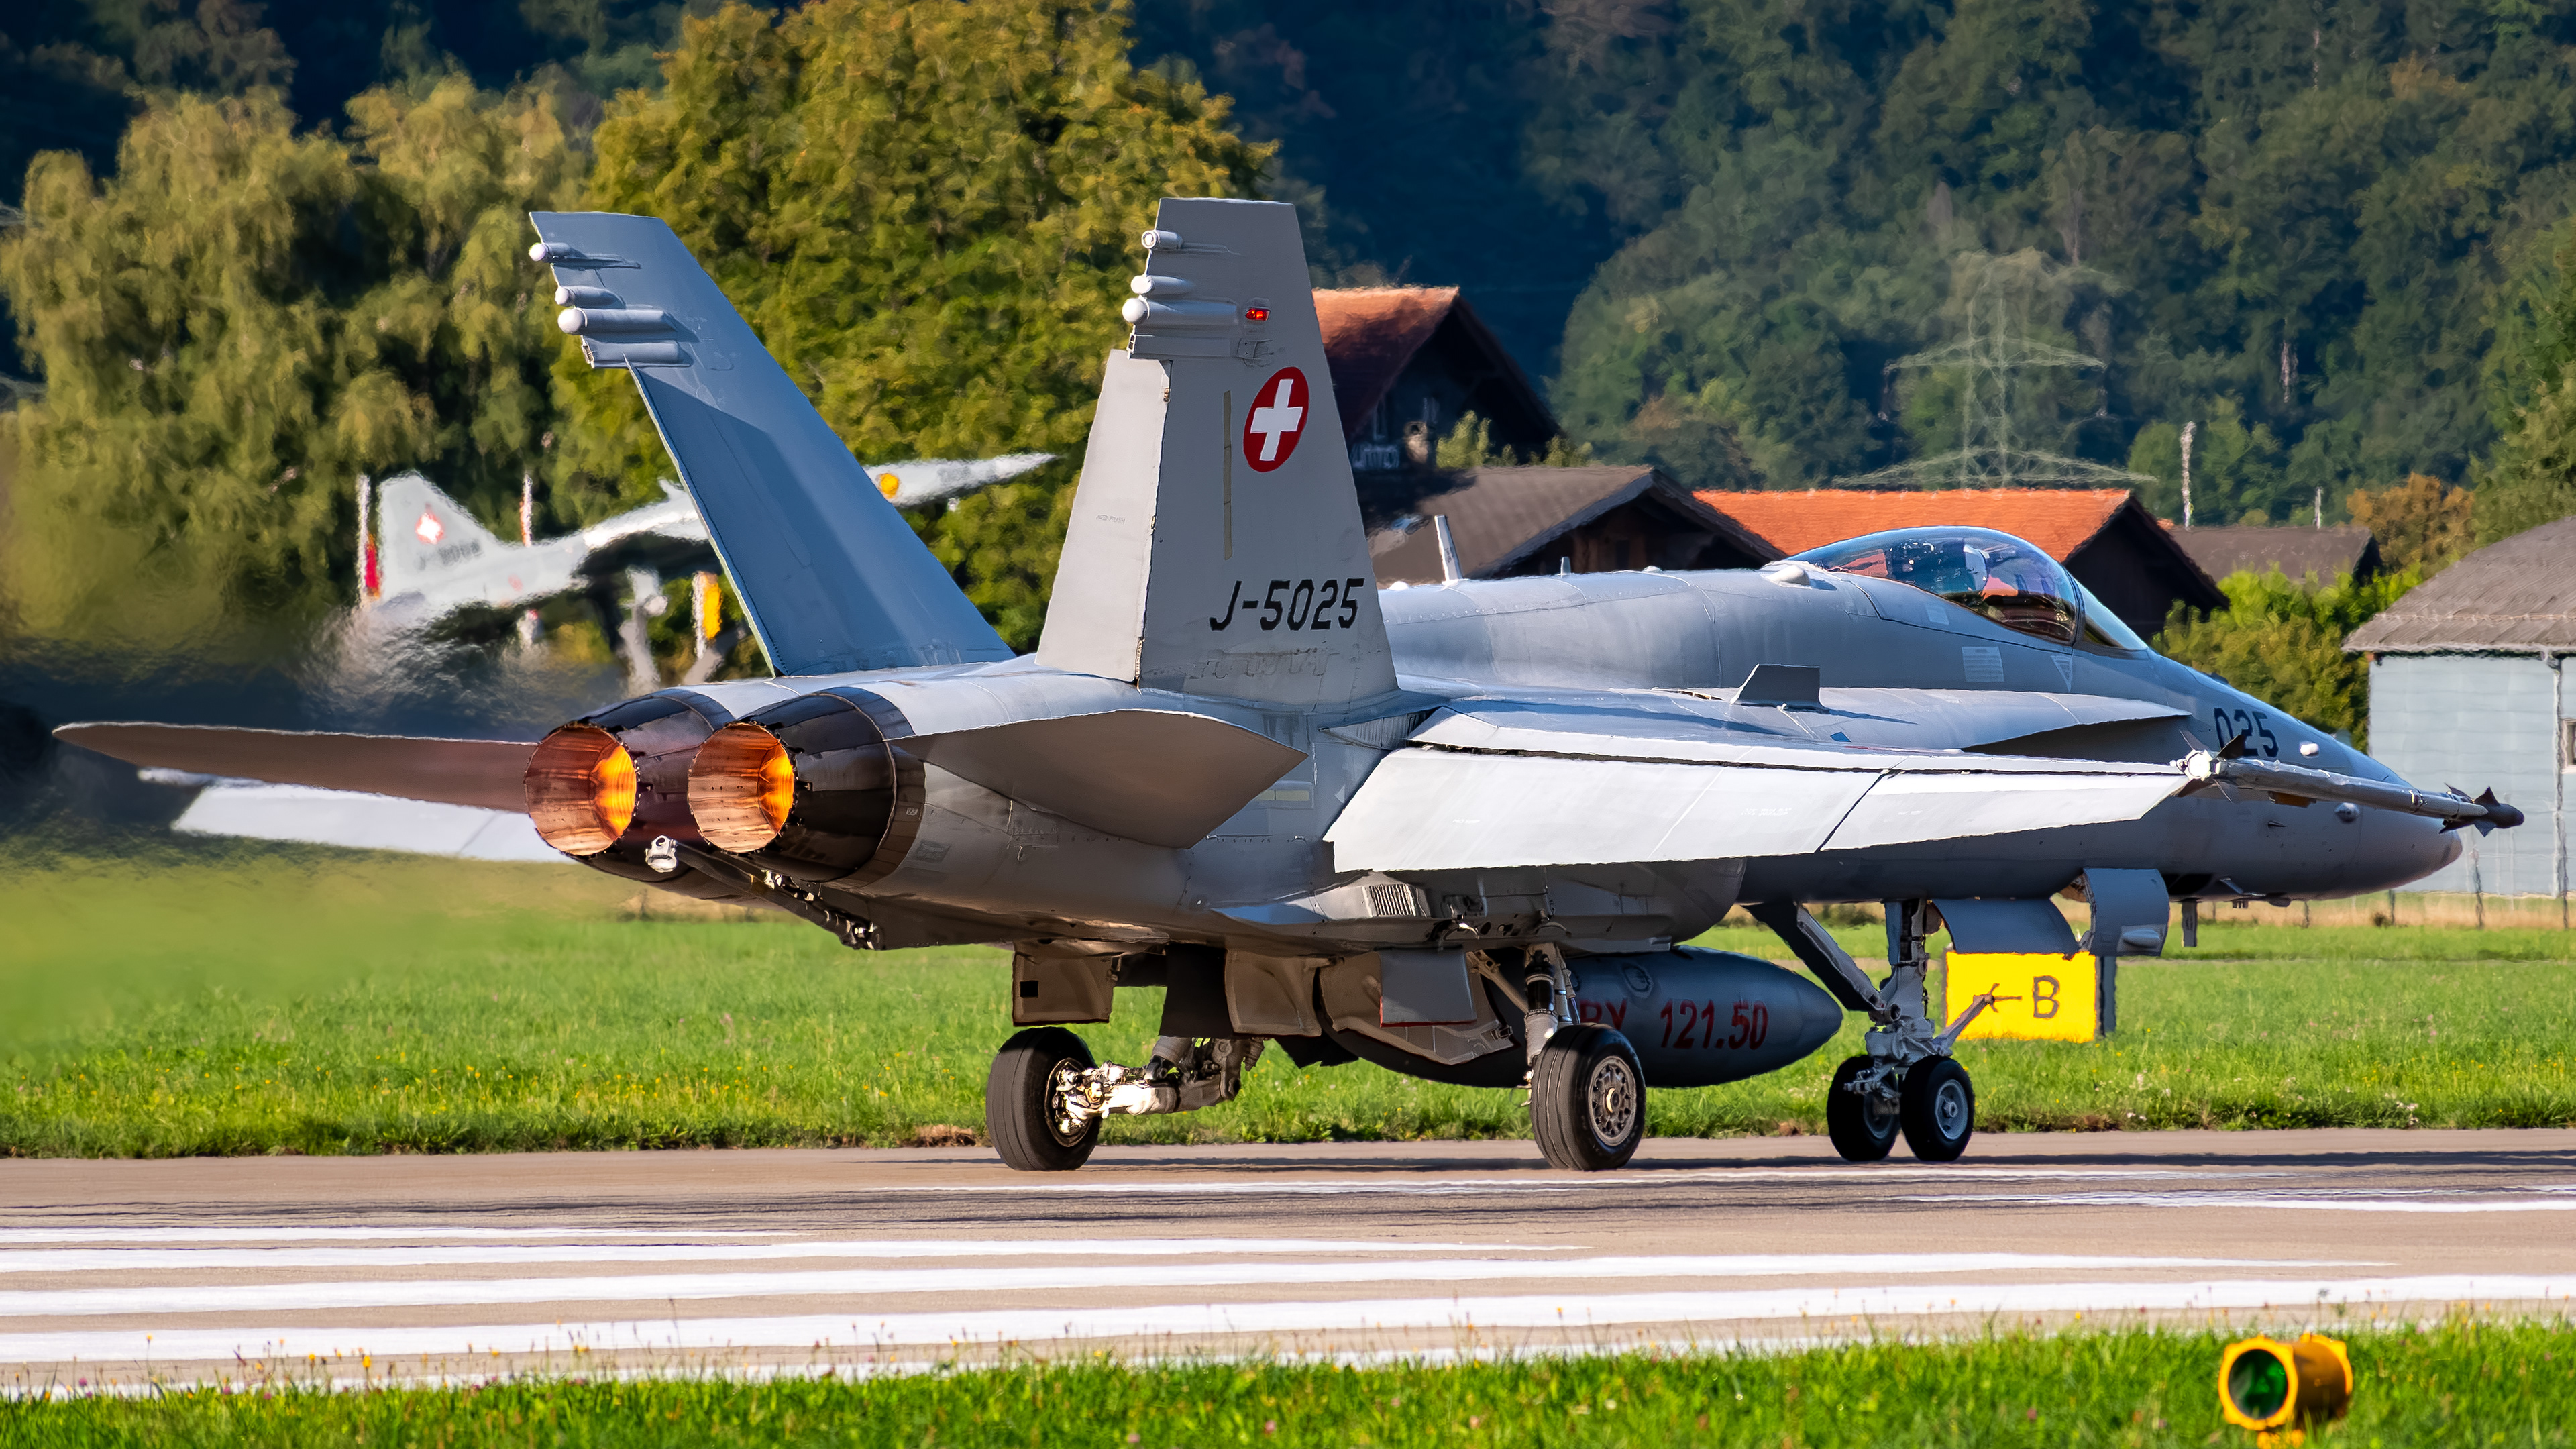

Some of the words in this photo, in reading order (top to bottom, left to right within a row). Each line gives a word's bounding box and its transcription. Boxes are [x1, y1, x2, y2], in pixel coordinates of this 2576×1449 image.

[1209, 578, 1366, 631] J-5025
[2214, 707, 2279, 757] 025
[2033, 975, 2060, 1018] B
[1660, 1000, 1769, 1050] 121.50
